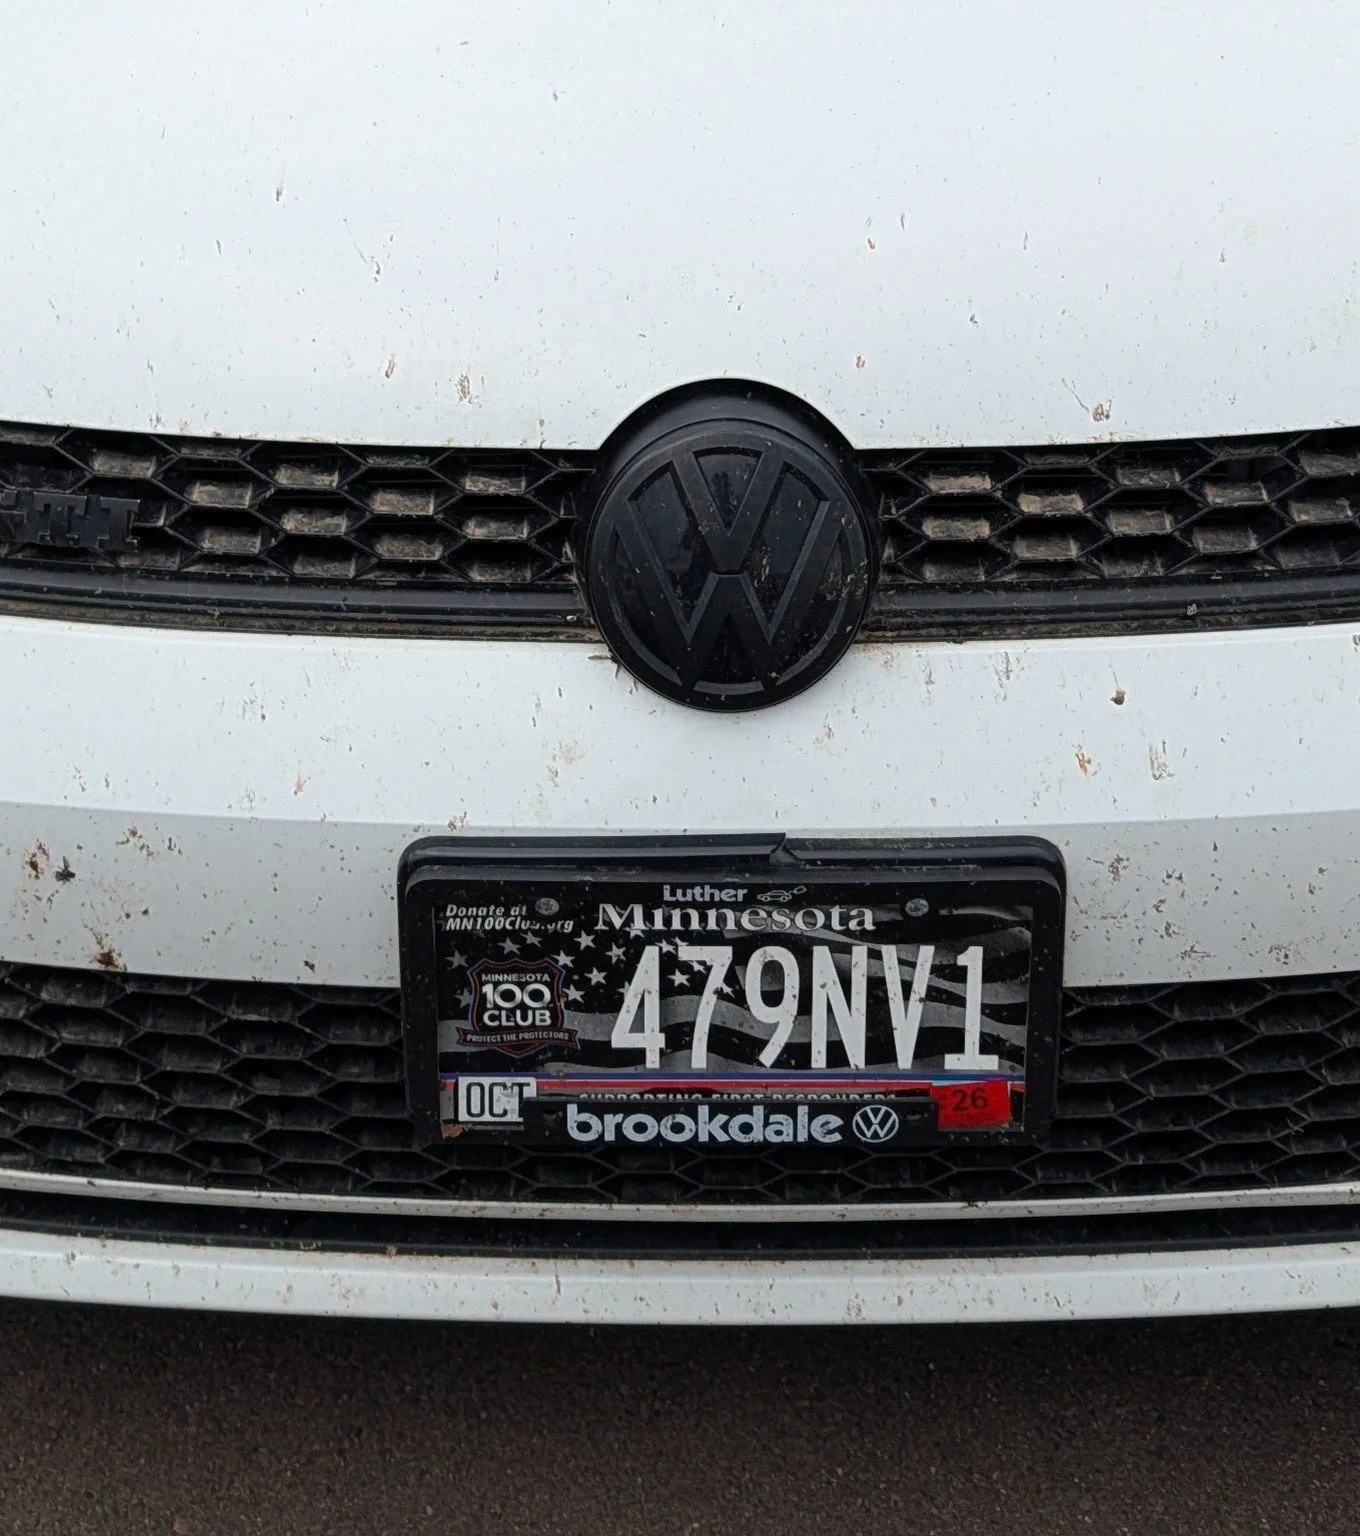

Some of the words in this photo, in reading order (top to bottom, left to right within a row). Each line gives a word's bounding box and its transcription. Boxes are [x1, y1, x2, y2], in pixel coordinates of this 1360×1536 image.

[663, 885, 748, 902] Luther
[446, 904, 505, 917] Donate
[510, 904, 527, 916] at
[594, 903, 876, 931] Minnesota
[482, 973, 550, 982] MINNESOTA
[482, 983, 551, 1008] 100
[611, 945, 999, 1070] 479NV1
[483, 1009, 552, 1026] CLUB
[467, 1034, 501, 1043] PROTECT
[502, 1034, 517, 1043] THE
[519, 1030, 570, 1041] PROTECTORS
[465, 1082, 530, 1118] OCT
[950, 1087, 989, 1112] 26
[566, 1104, 843, 1143] brookdale
